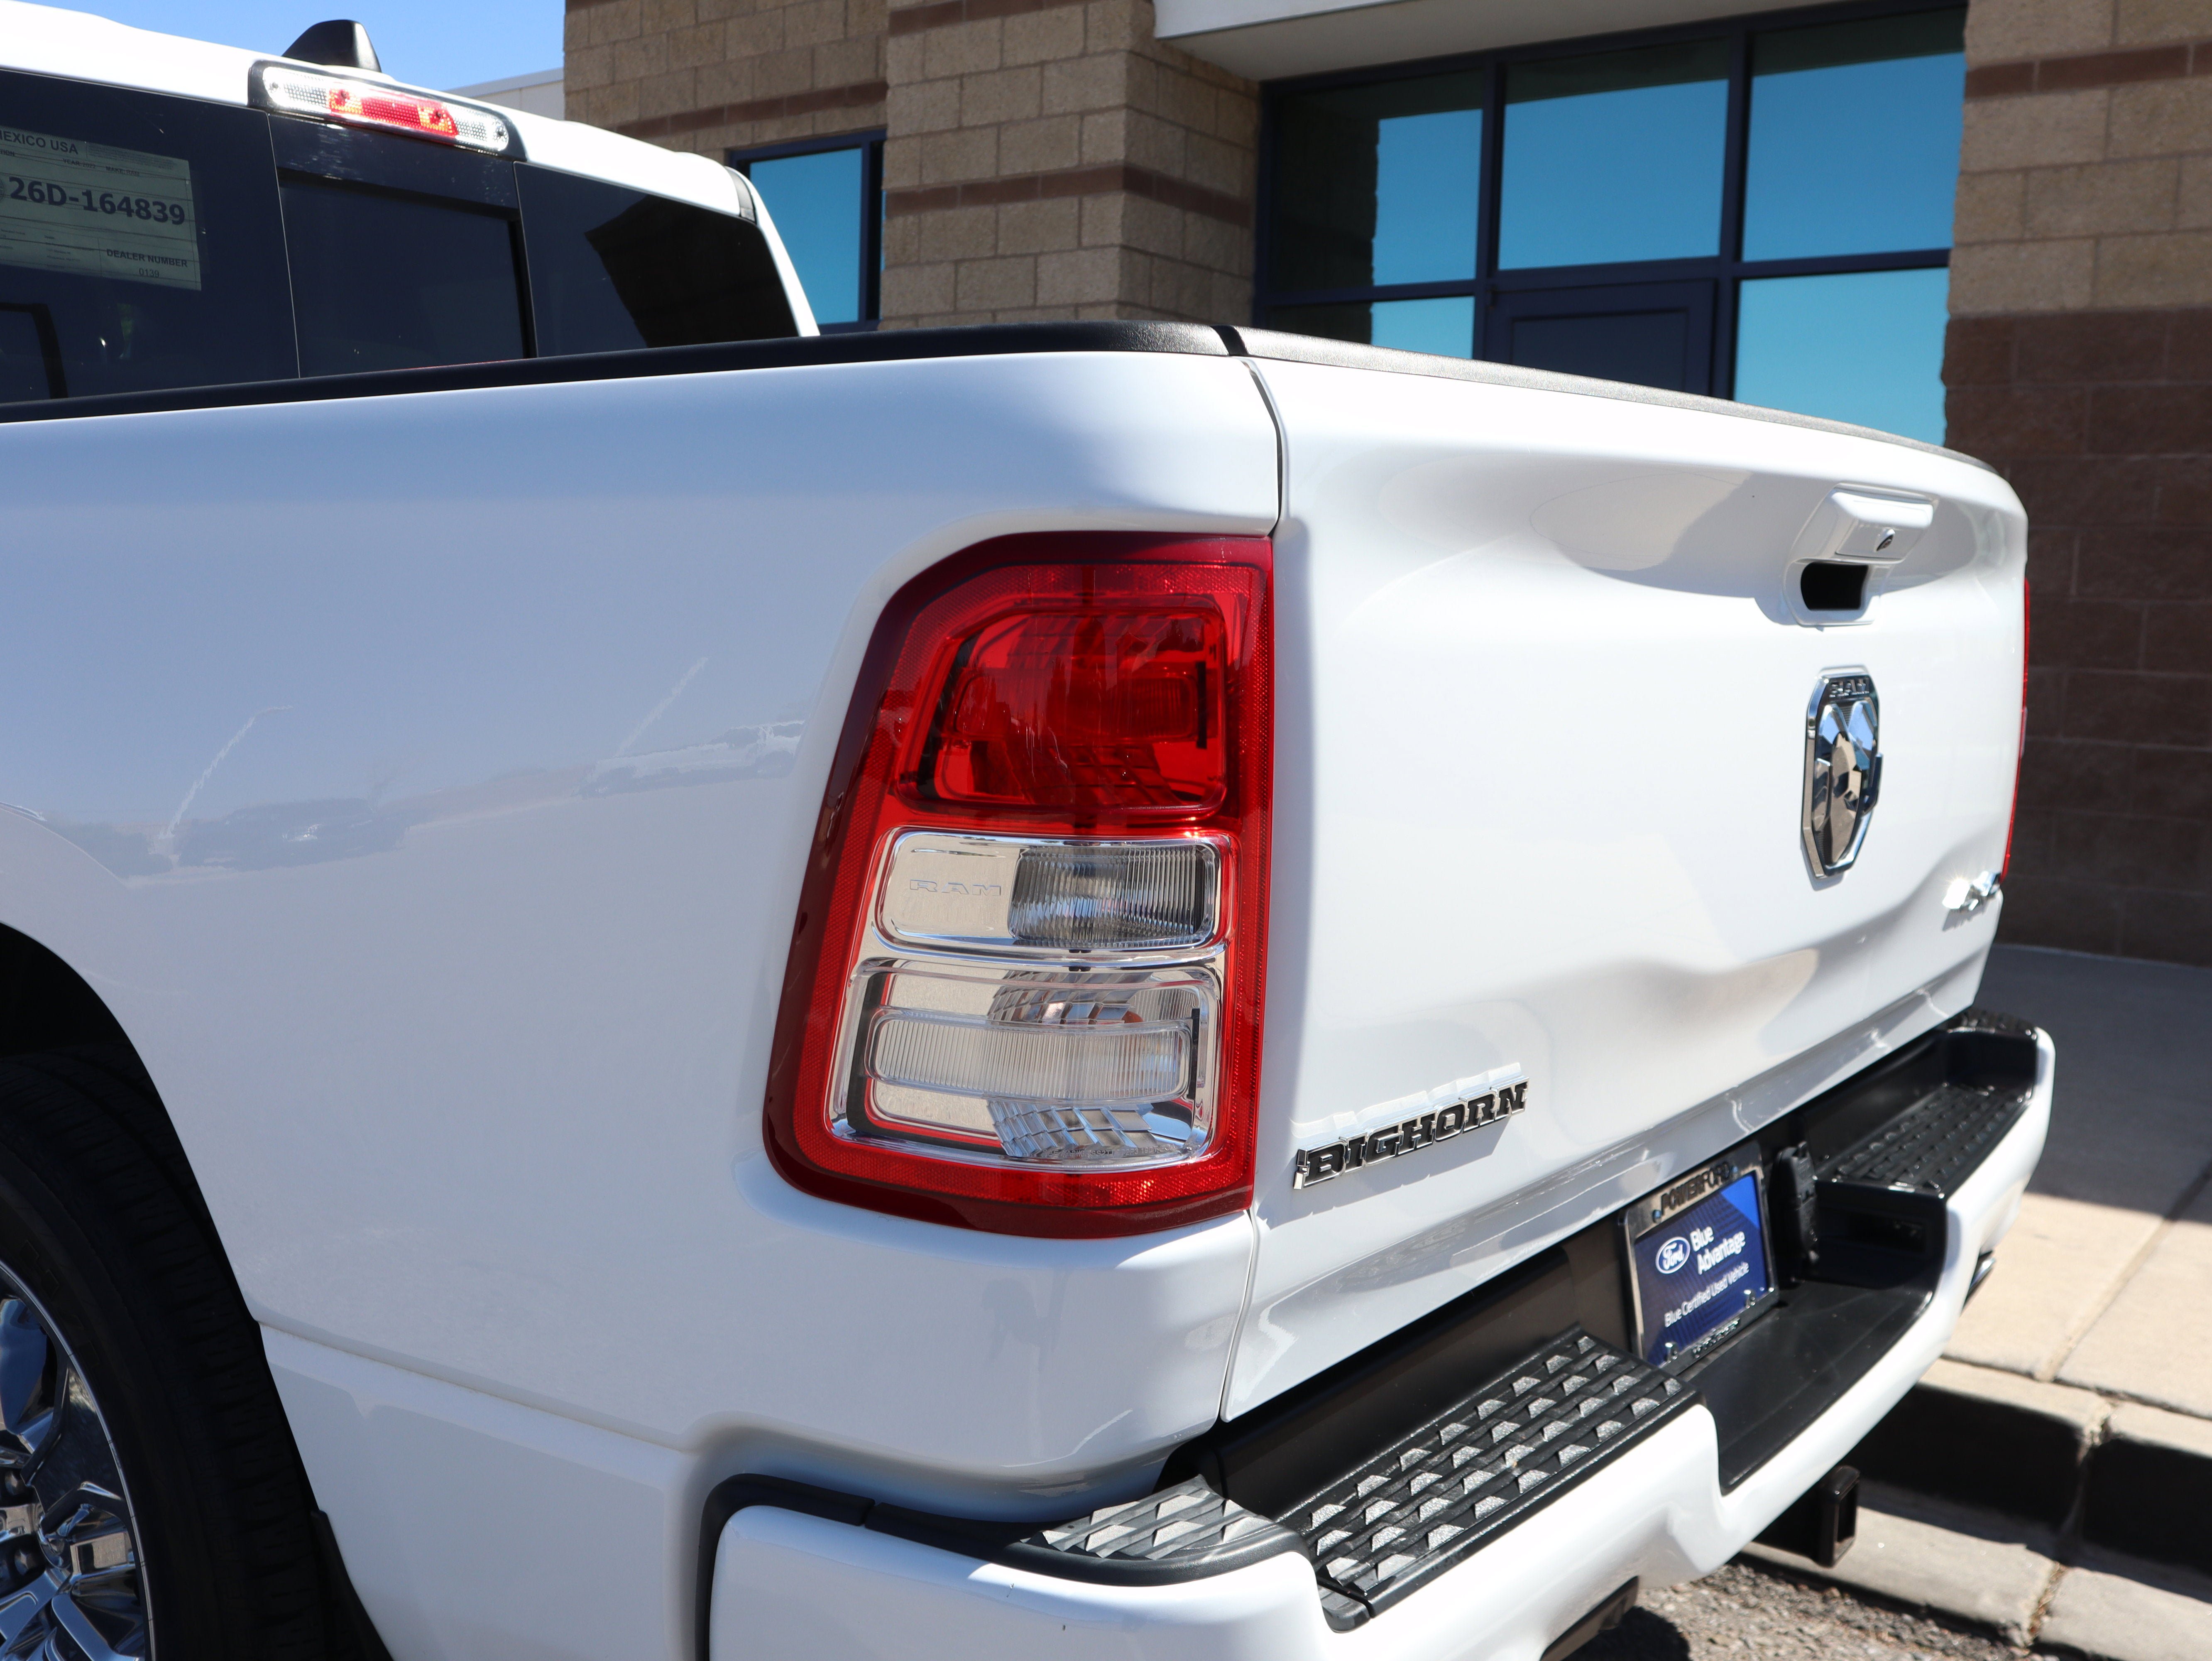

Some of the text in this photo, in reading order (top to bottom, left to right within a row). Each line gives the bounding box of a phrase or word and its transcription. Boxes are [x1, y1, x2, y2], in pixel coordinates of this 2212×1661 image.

[0, 130, 78, 154] EXICO USA
[9, 176, 185, 225] 26D-164839
[107, 248, 145, 261] DEALER
[147, 255, 188, 267] NUMBER
[139, 267, 159, 278] 0139
[910, 879, 1001, 896] RAM
[1690, 1226, 1714, 1252] Blue
[1662, 1242, 1685, 1270] Ford
[1697, 1231, 1746, 1275] Advantage
[1664, 1261, 1750, 1328] Blue Certified Used Vehicle
